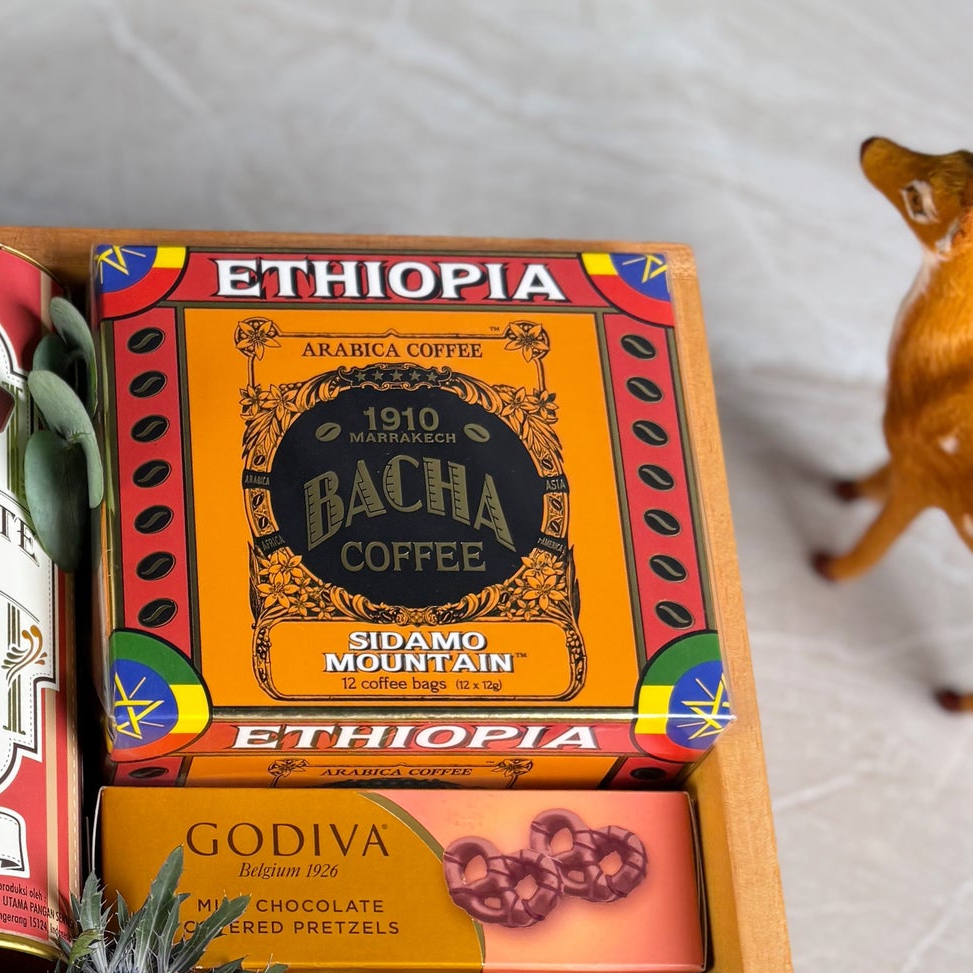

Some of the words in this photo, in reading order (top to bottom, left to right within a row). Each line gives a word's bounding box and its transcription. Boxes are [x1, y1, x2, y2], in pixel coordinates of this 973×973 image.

[213, 256, 569, 302] ETHIOPIA
[301, 341, 400, 359] ARABICA
[406, 341, 484, 359] COFFEE
[362, 406, 440, 432] 1910
[349, 430, 457, 444] MARRAKECH
[545, 478, 567, 491] ASIA
[303, 453, 517, 553] BACHA
[340, 540, 488, 574] COFFEE
[349, 630, 487, 652] SIDAMO
[322, 651, 515, 674] MOUNTAIN
[342, 676, 357, 690] 12
[360, 675, 406, 691] coffee
[410, 675, 447, 694] bags
[455, 677, 470, 692] (12
[482, 677, 503, 693] 12g)
[233, 724, 600, 751] ETHIOPIA
[321, 766, 403, 777] ARABICA
[408, 766, 473, 777] COFFEE
[185, 822, 390, 858] GODIVA
[238, 862, 303, 881] Belgium
[306, 863, 339, 878] 1926
[2, 895, 28, 912] UTAMA
[197, 899, 219, 913] MI
[255, 898, 385, 914] CHOCOLATE
[183, 920, 284, 935] CERED
[293, 920, 400, 935] PRETZELS
